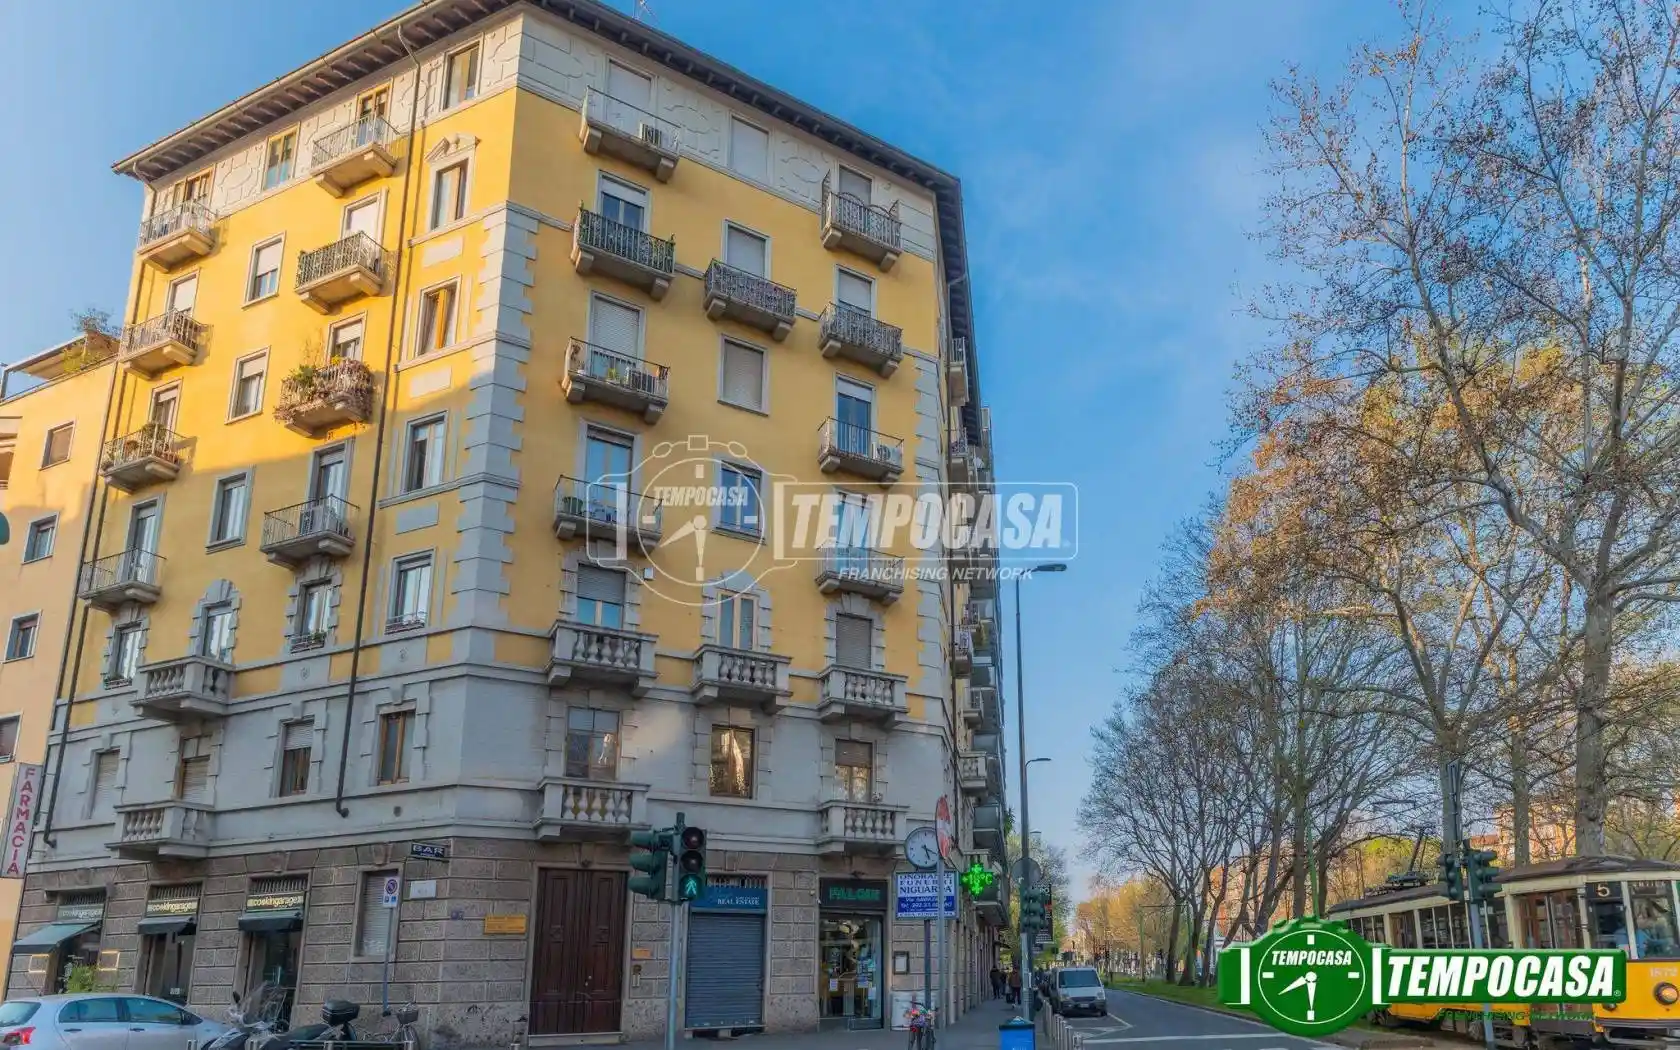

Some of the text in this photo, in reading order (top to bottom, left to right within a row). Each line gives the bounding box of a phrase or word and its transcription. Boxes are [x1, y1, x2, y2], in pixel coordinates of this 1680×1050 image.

[7, 767, 35, 874] FARMACIA
[412, 844, 445, 854] BAR
[1597, 882, 1610, 897] 5
[717, 898, 734, 906] REAL
